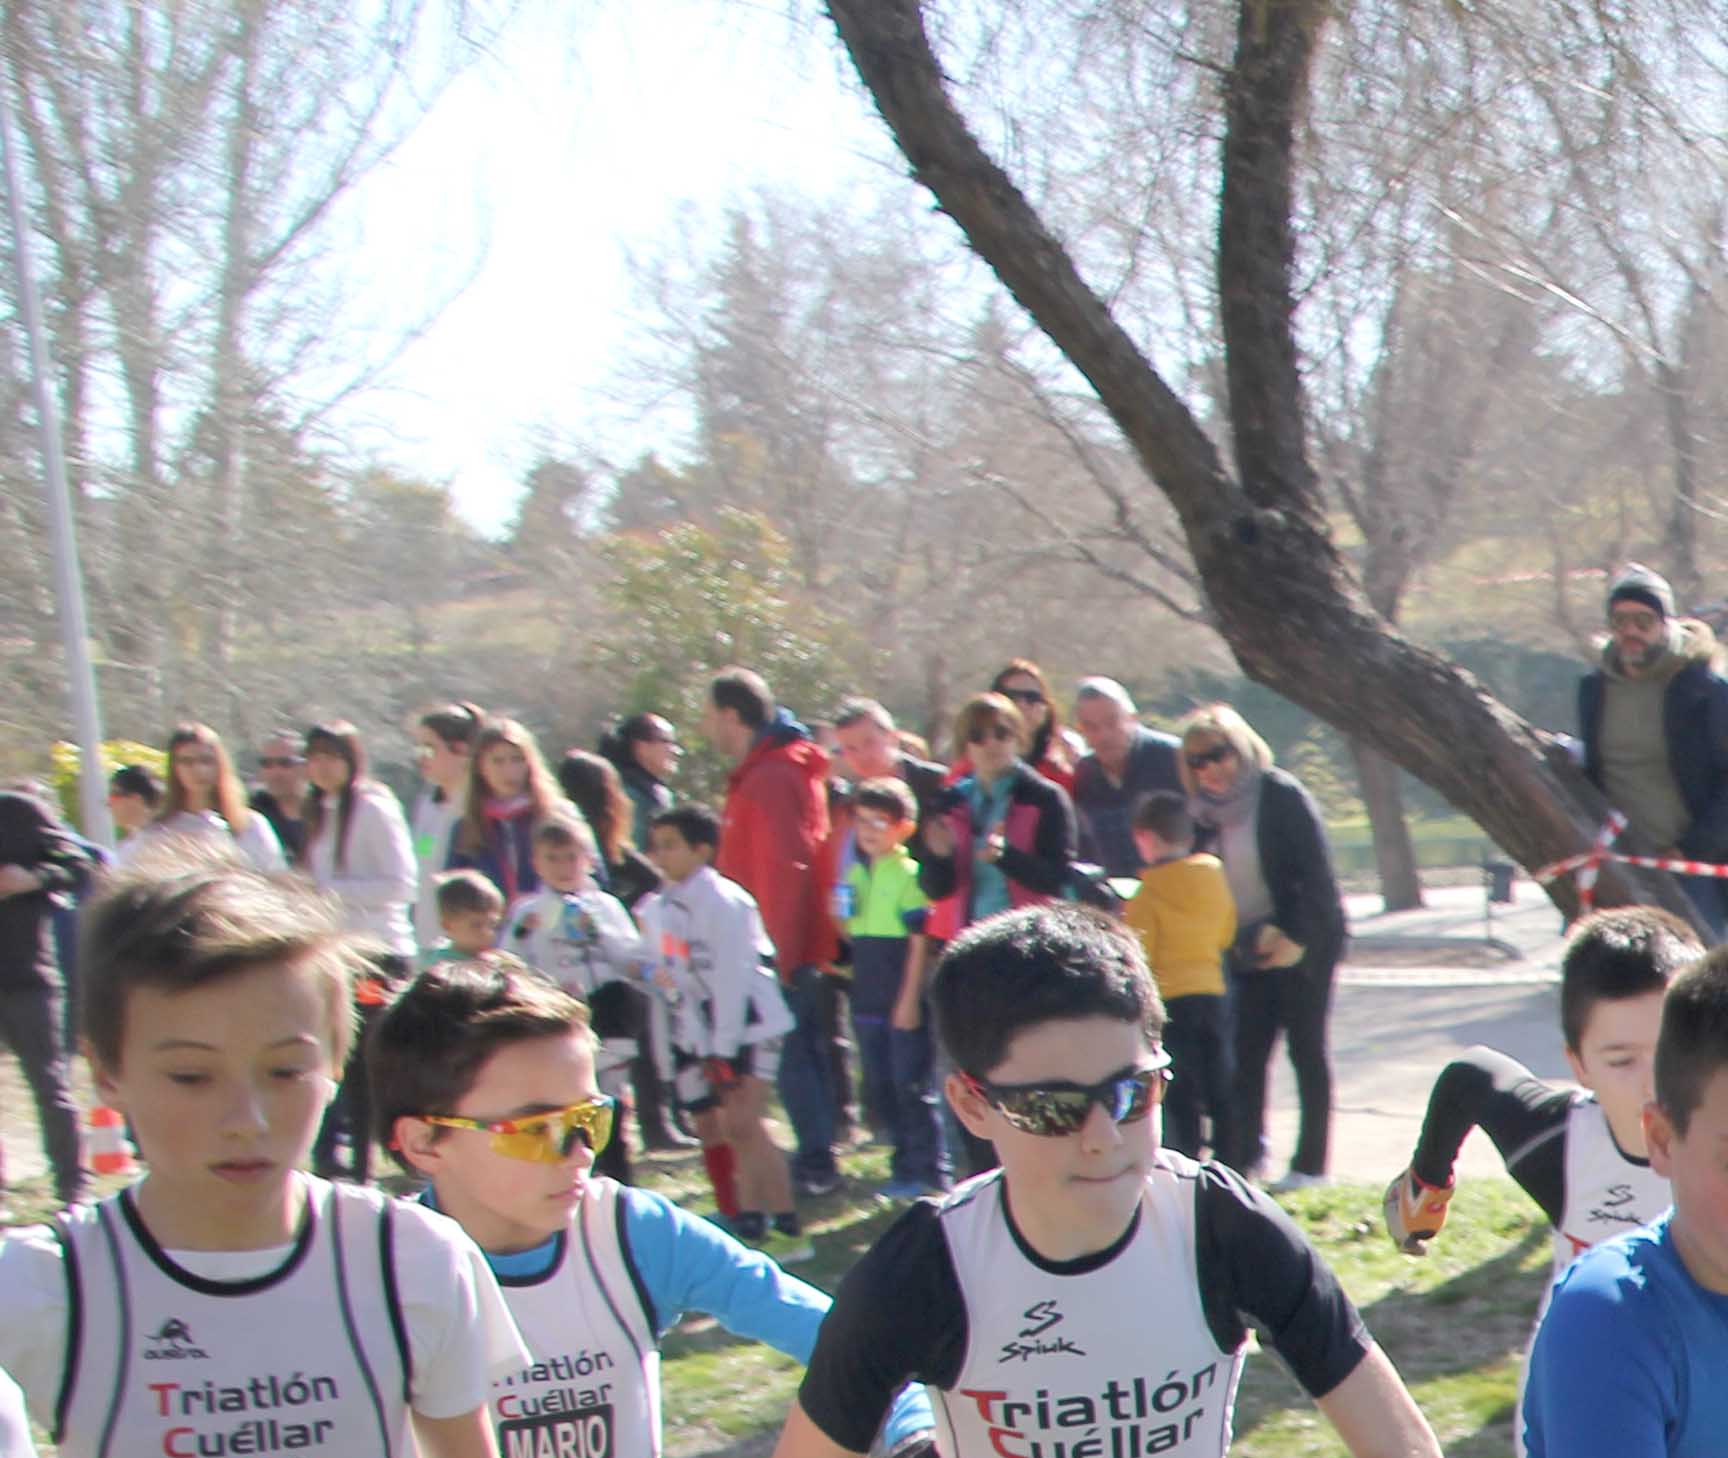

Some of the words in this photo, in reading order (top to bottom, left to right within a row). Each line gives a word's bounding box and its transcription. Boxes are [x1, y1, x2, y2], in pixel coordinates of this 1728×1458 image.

[507, 1349, 614, 1385] iatlón
[998, 1337, 1087, 1363] Spiuk
[147, 1371, 340, 1417] Triatlón
[497, 1383, 612, 1418] Cuéllar
[960, 1363, 1217, 1430] Triatlón
[163, 1419, 335, 1458] Cuéllar
